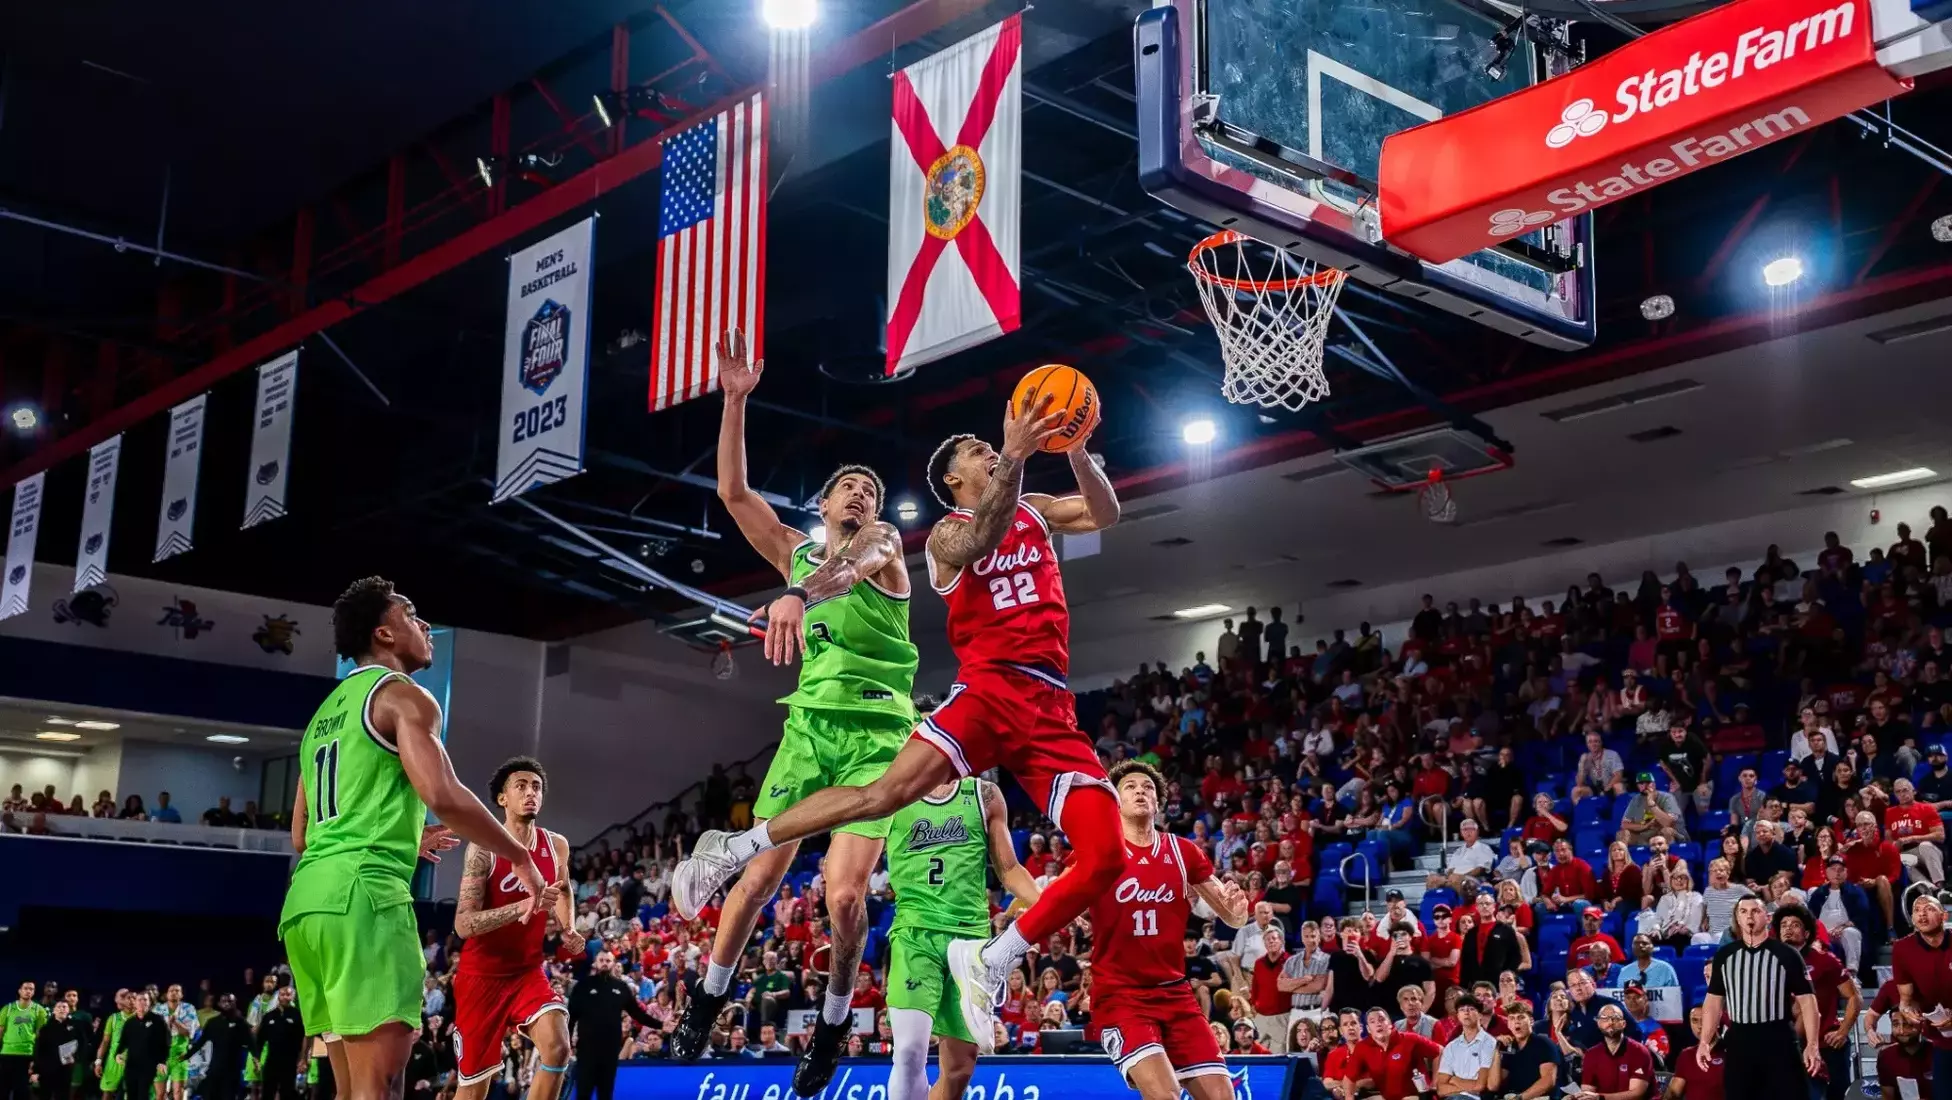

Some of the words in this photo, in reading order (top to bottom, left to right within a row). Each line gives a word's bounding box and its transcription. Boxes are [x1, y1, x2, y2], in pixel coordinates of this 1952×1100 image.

[536, 249, 564, 273] MEN'S
[520, 262, 578, 298] BASKETBALL
[529, 318, 563, 350] FINAL
[531, 338, 564, 371] FOUR
[512, 394, 568, 444] 2023
[1061, 387, 1092, 438] Wilson
[989, 571, 1040, 611] 22
[314, 738, 340, 824] 11
[907, 815, 968, 847] Bulls
[1891, 819, 1922, 831] OWLS
[927, 857, 945, 886] 2
[1115, 877, 1175, 903] Owls
[1132, 909, 1158, 936] 11
